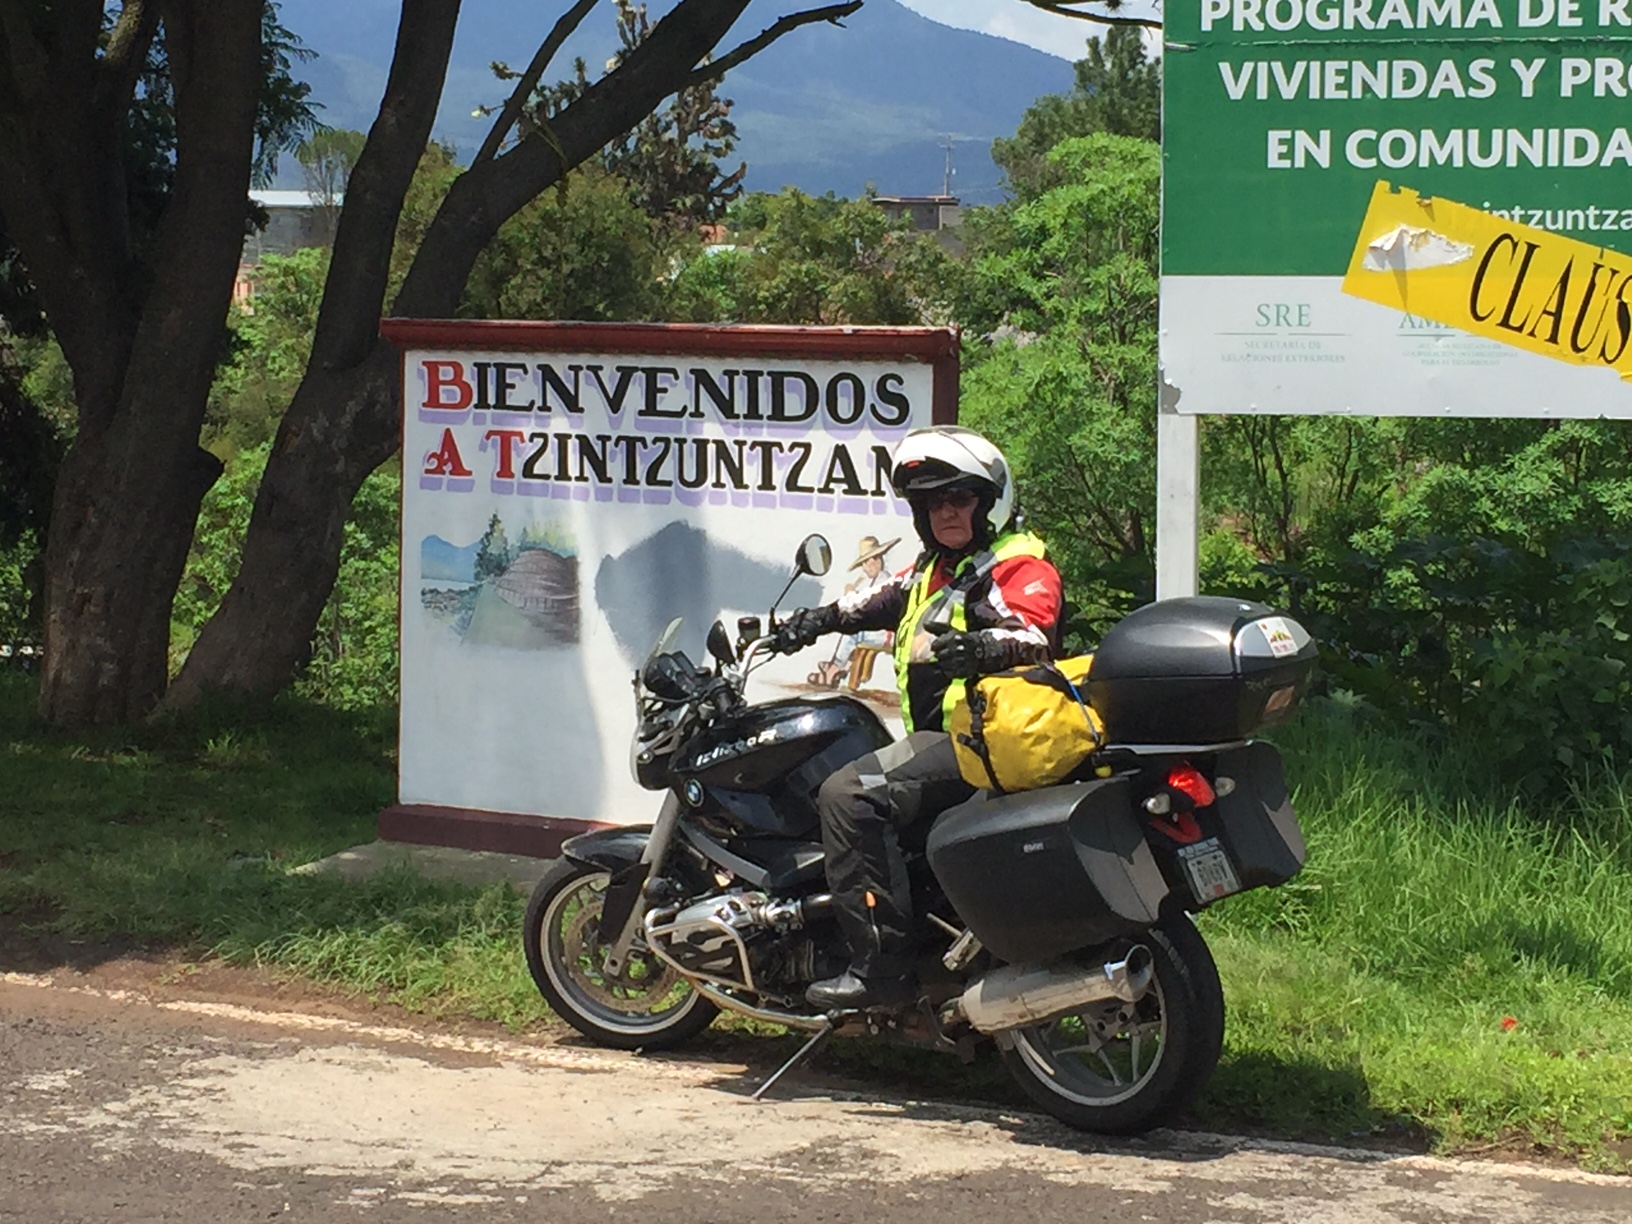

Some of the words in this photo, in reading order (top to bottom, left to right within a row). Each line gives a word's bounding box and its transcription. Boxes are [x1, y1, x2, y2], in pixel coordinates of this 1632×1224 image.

[1201, 0, 1503, 31] PROGRAMA
[1518, 0, 1583, 28] DE
[1218, 58, 1497, 100] VIVIENDAS
[1510, 57, 1547, 98] Y
[1560, 57, 1632, 98] PR
[1267, 129, 1331, 169] EN
[1345, 127, 1632, 169] COMUNIDA
[1256, 303, 1312, 328] SRE
[1470, 232, 1632, 365] CLAUS
[421, 360, 911, 426] BIENVENIDOS
[424, 427, 473, 477] A
[484, 430, 902, 498] TZINTZUNTZAN
